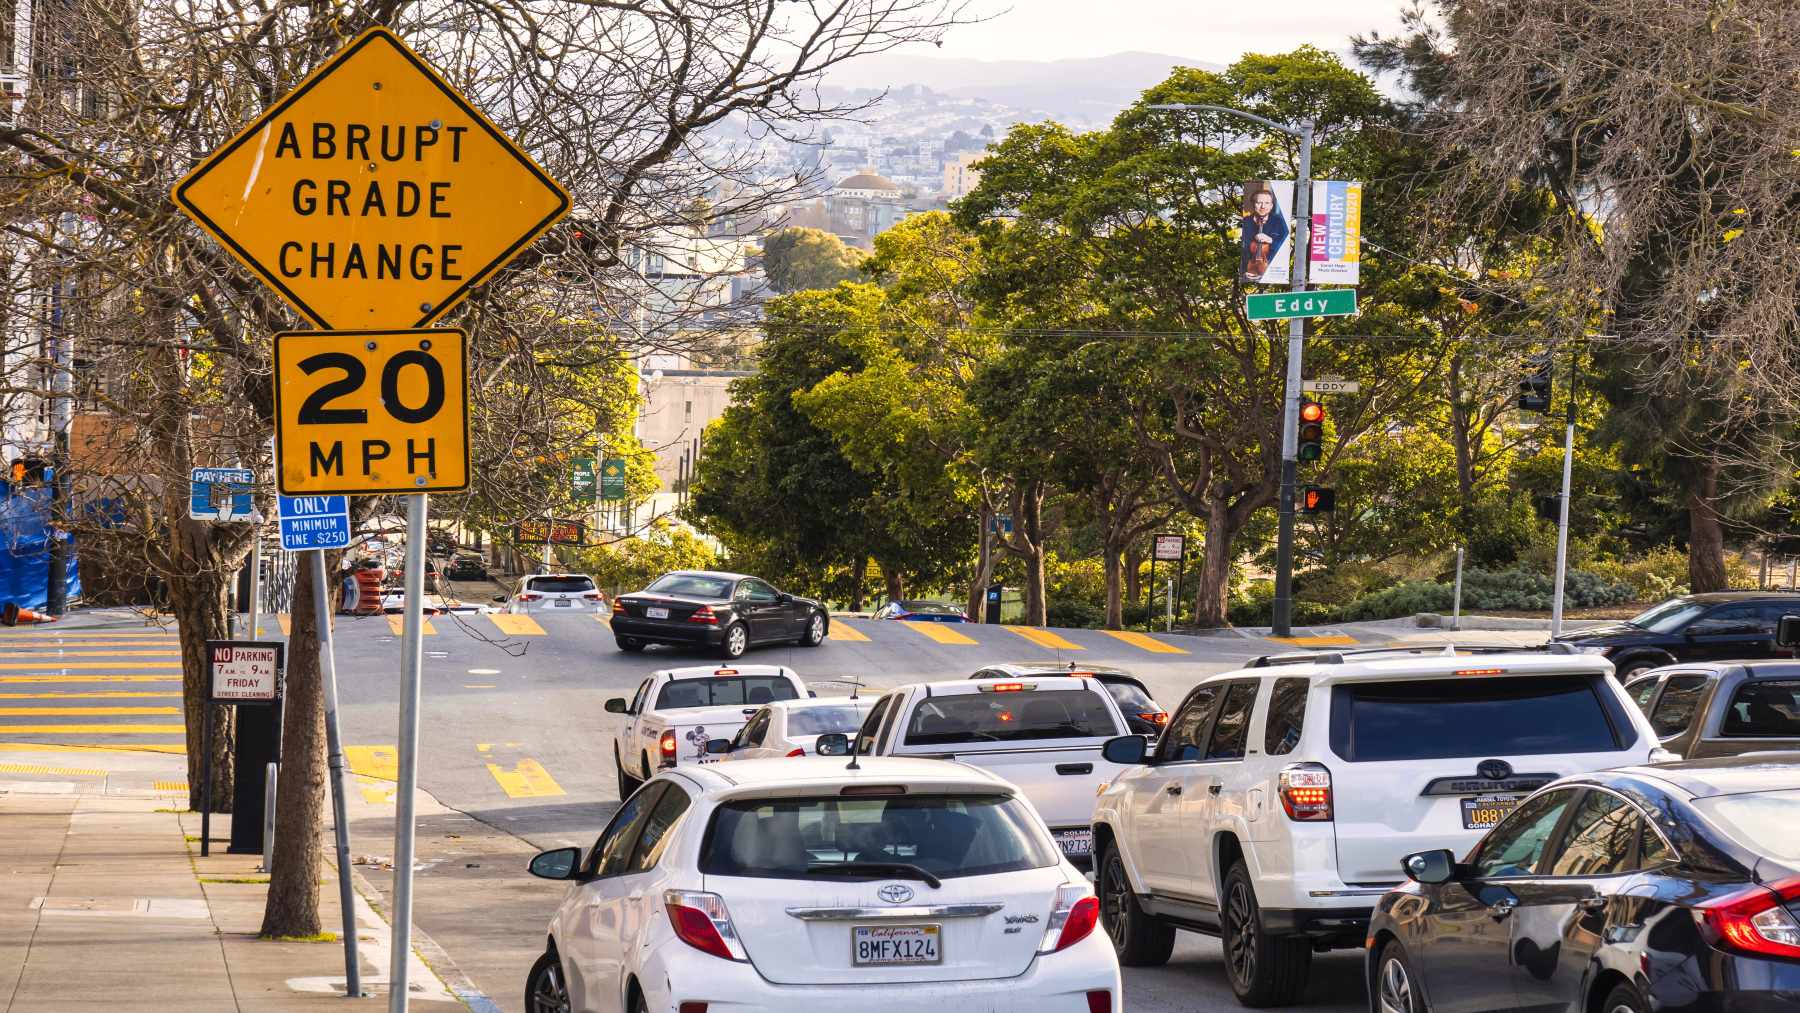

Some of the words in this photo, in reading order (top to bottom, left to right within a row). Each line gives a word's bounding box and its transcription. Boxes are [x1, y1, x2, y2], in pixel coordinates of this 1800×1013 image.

[275, 121, 468, 163] ABRUPT
[292, 179, 452, 218] GRADE
[1328, 193, 1344, 257] CENTURY
[1312, 223, 1328, 255] NEW
[279, 240, 463, 281] CHANGE
[1274, 298, 1328, 313] Eddy
[296, 350, 445, 425] 20
[309, 438, 437, 479] MPH
[195, 471, 217, 483] PAY
[293, 496, 330, 514] ONLY
[291, 518, 337, 532] MINIMUM
[285, 534, 309, 546] FINE
[316, 531, 346, 544] $250
[214, 648, 231, 662] NO
[235, 651, 273, 662] PARKING
[217, 664, 224, 674] 7
[251, 664, 258, 674] 9
[227, 678, 260, 688] FRIDAY
[871, 927, 920, 940] California
[859, 939, 936, 959] 8MFX124
